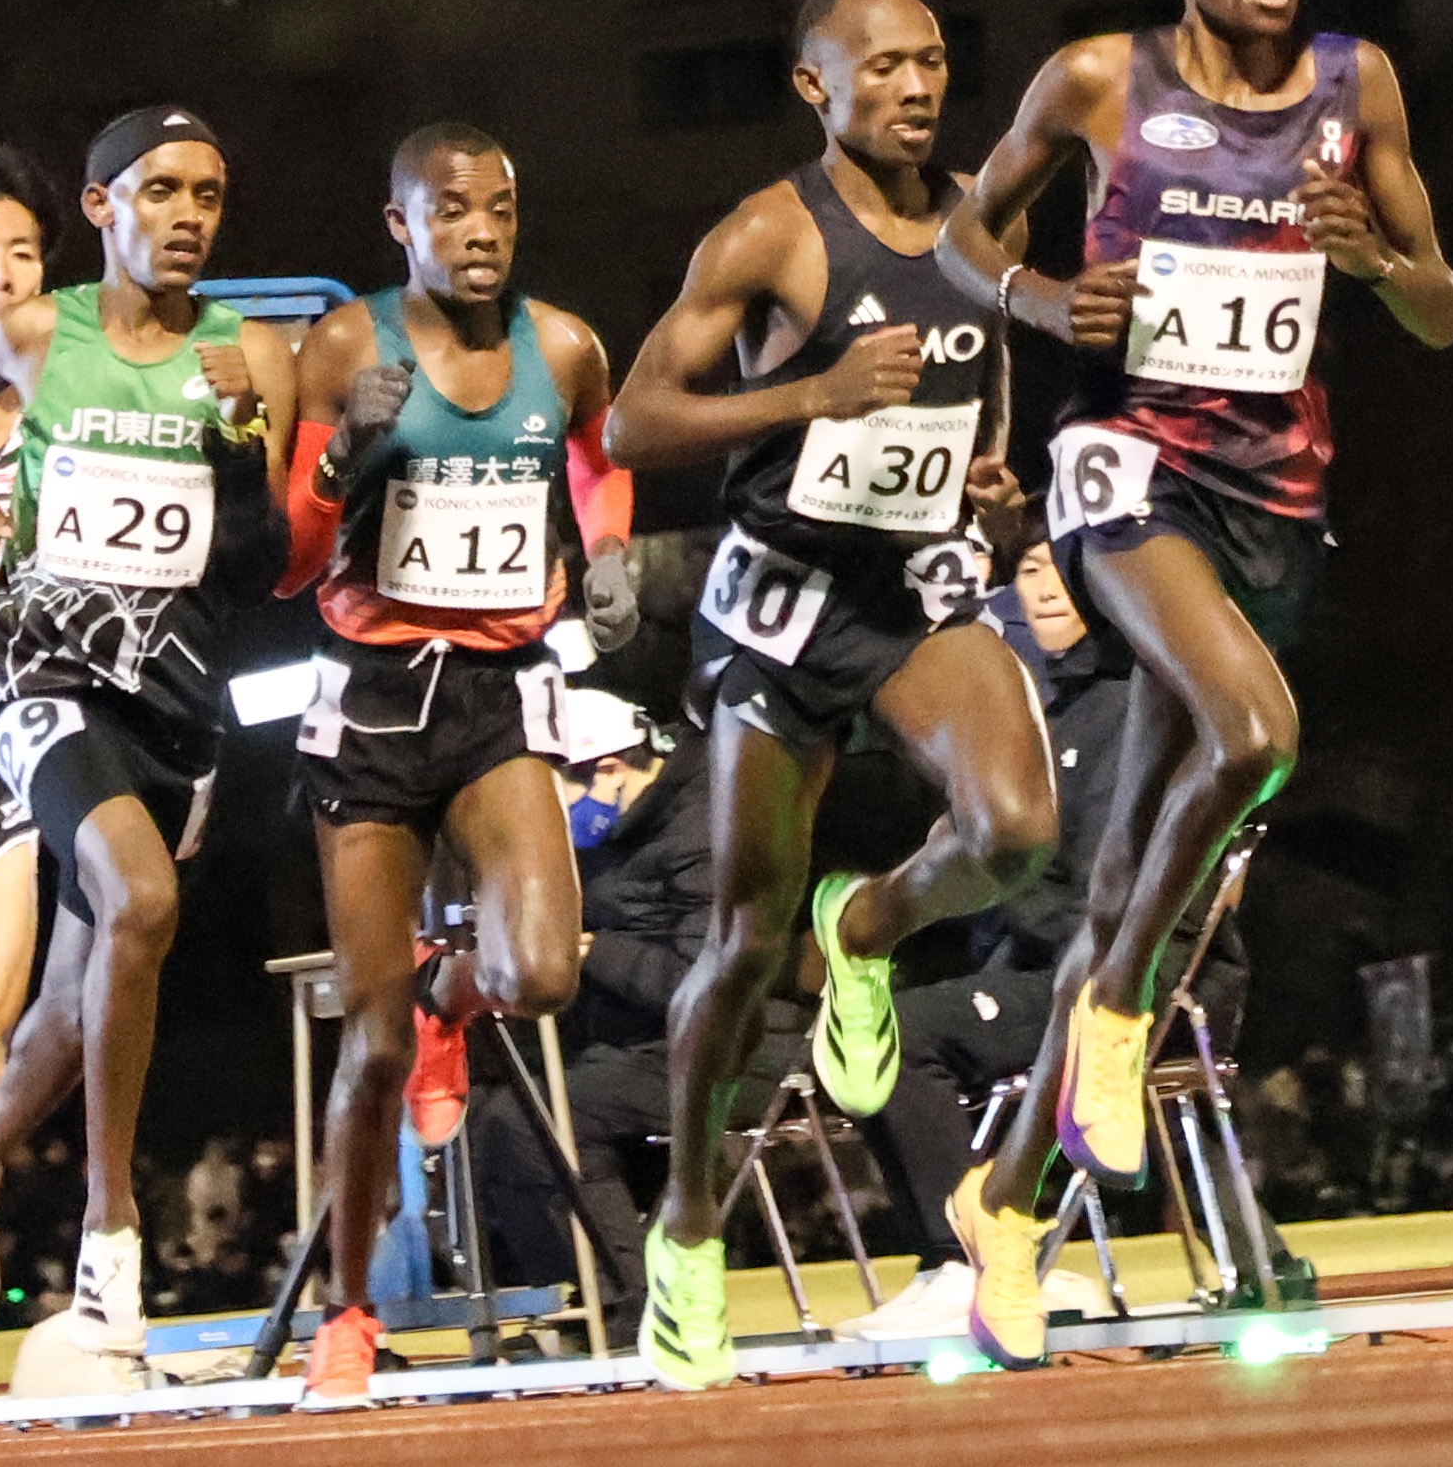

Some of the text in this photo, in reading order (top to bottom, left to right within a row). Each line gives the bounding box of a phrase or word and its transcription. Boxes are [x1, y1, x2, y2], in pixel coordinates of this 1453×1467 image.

[1160, 188, 1306, 226] SUBAR
[1183, 262, 1316, 282] KONICA MINOLTA
[920, 324, 985, 364] MO
[1153, 296, 1301, 355] A 16
[857, 416, 969, 432] KONICA MINOLTA
[82, 465, 139, 482] KONICA
[817, 445, 952, 498] A 30
[424, 495, 539, 511] KONICA MINOLTA
[54, 496, 191, 555] A 29
[398, 523, 528, 575] A 12
[715, 545, 802, 639] 30
